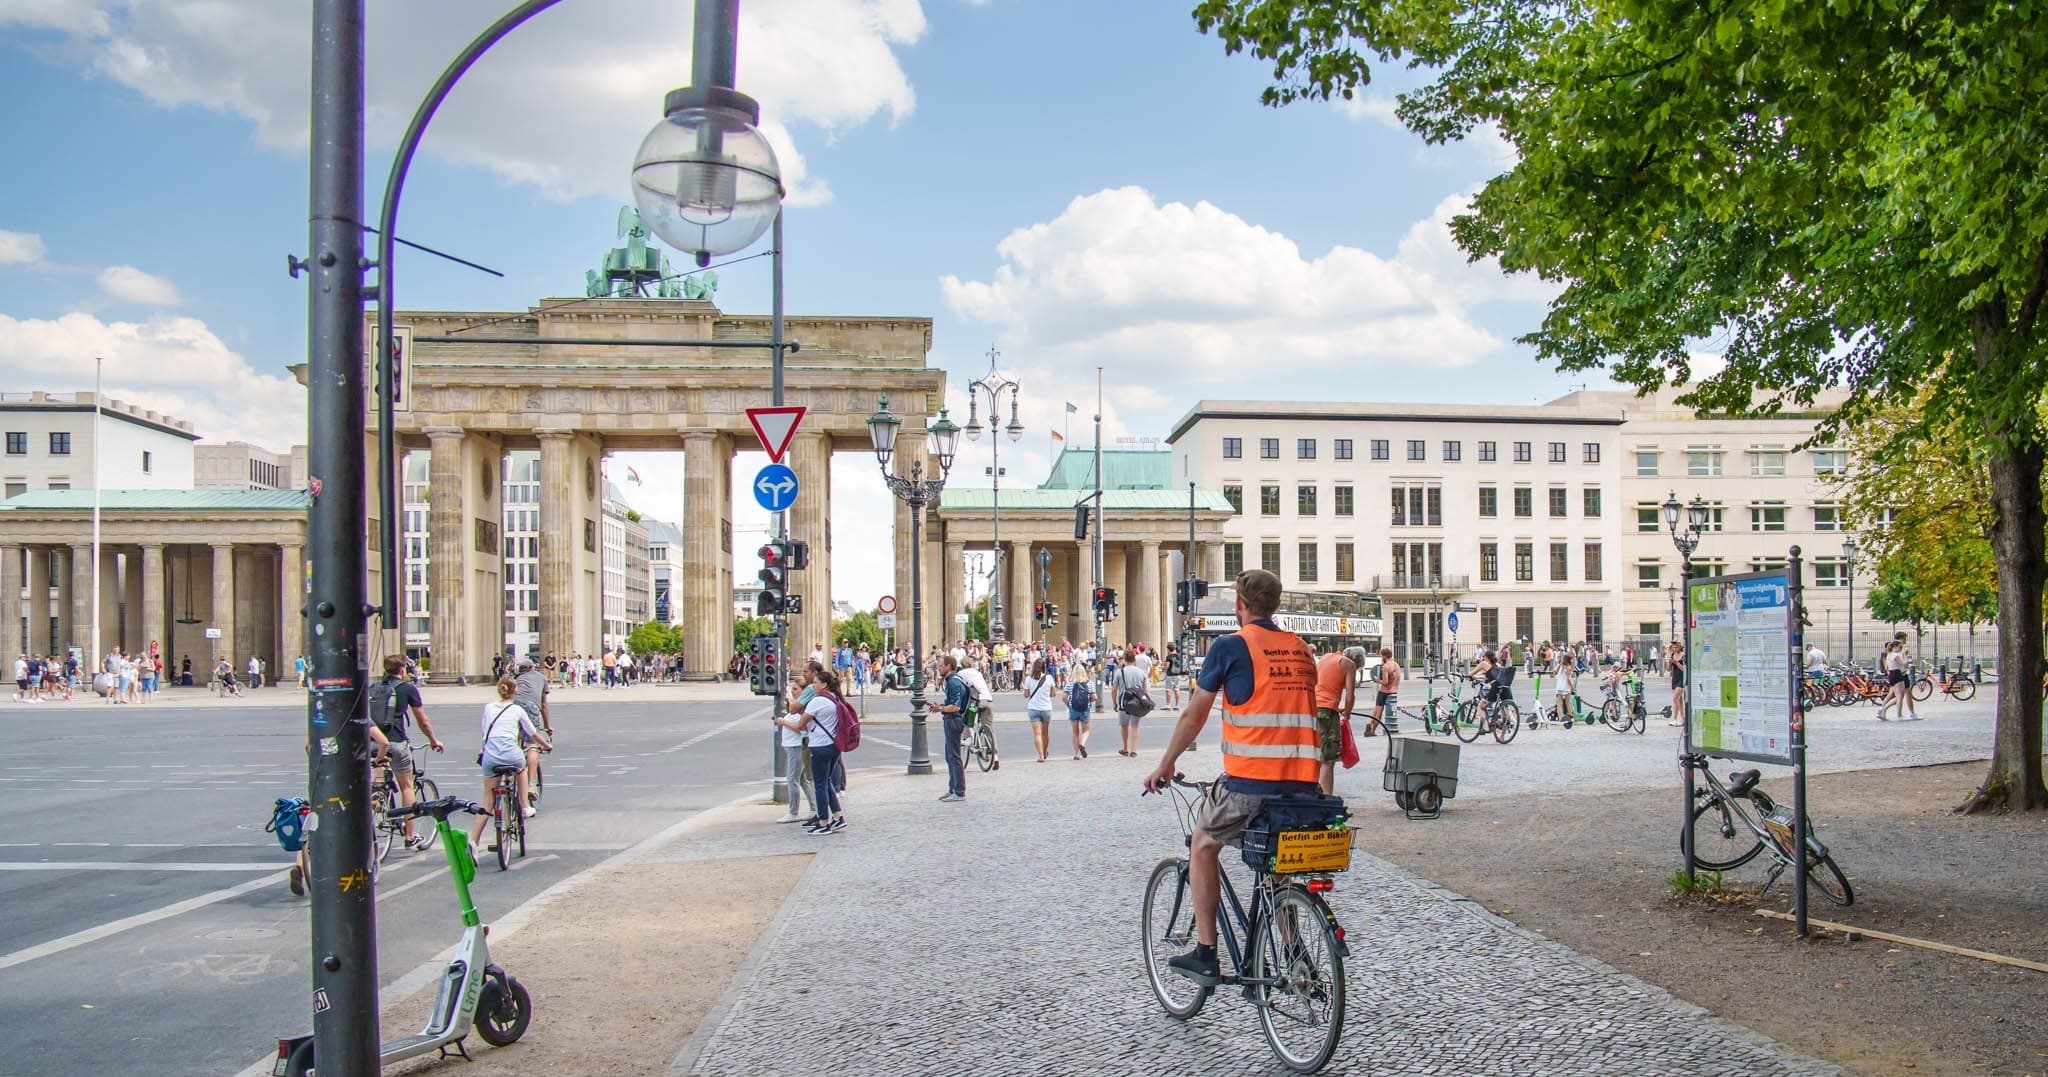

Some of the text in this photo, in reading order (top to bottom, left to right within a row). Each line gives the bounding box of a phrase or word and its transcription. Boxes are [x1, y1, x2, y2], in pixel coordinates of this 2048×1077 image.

[1282, 616, 1380, 634] STADTRUNDFAHRTEN SIGHTSEEING
[1282, 833, 1310, 841] Berlin
[1313, 832, 1325, 841] on
[462, 969, 480, 1013] Lime
